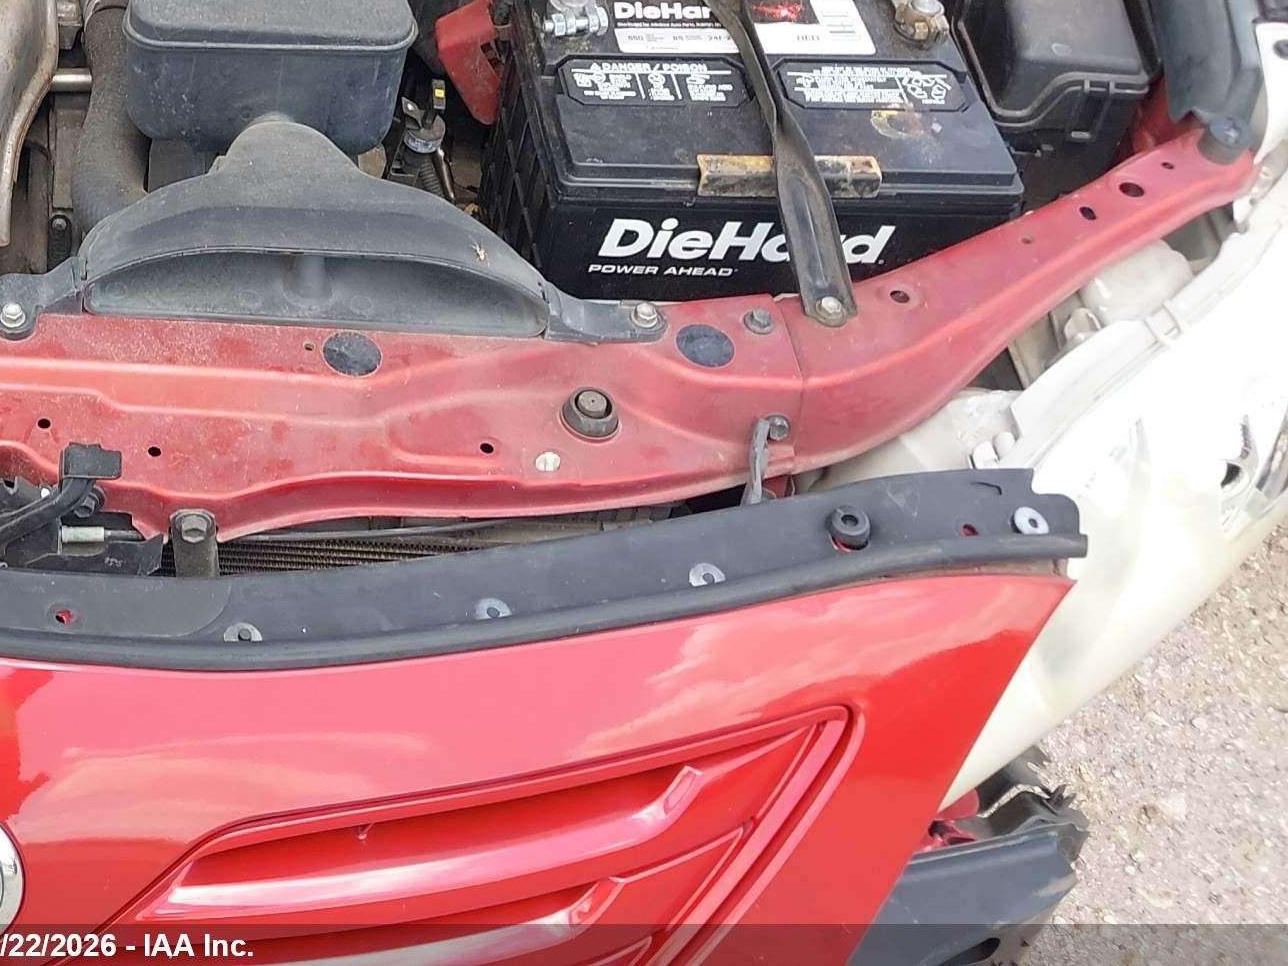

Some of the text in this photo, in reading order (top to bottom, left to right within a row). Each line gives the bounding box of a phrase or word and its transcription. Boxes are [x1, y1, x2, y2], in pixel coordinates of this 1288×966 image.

[613, 1, 712, 20] DieHar
[601, 63, 651, 72] DANGER
[663, 64, 708, 72] POISON
[598, 218, 896, 264] DieHad
[588, 264, 733, 277] POWER AHEAD
